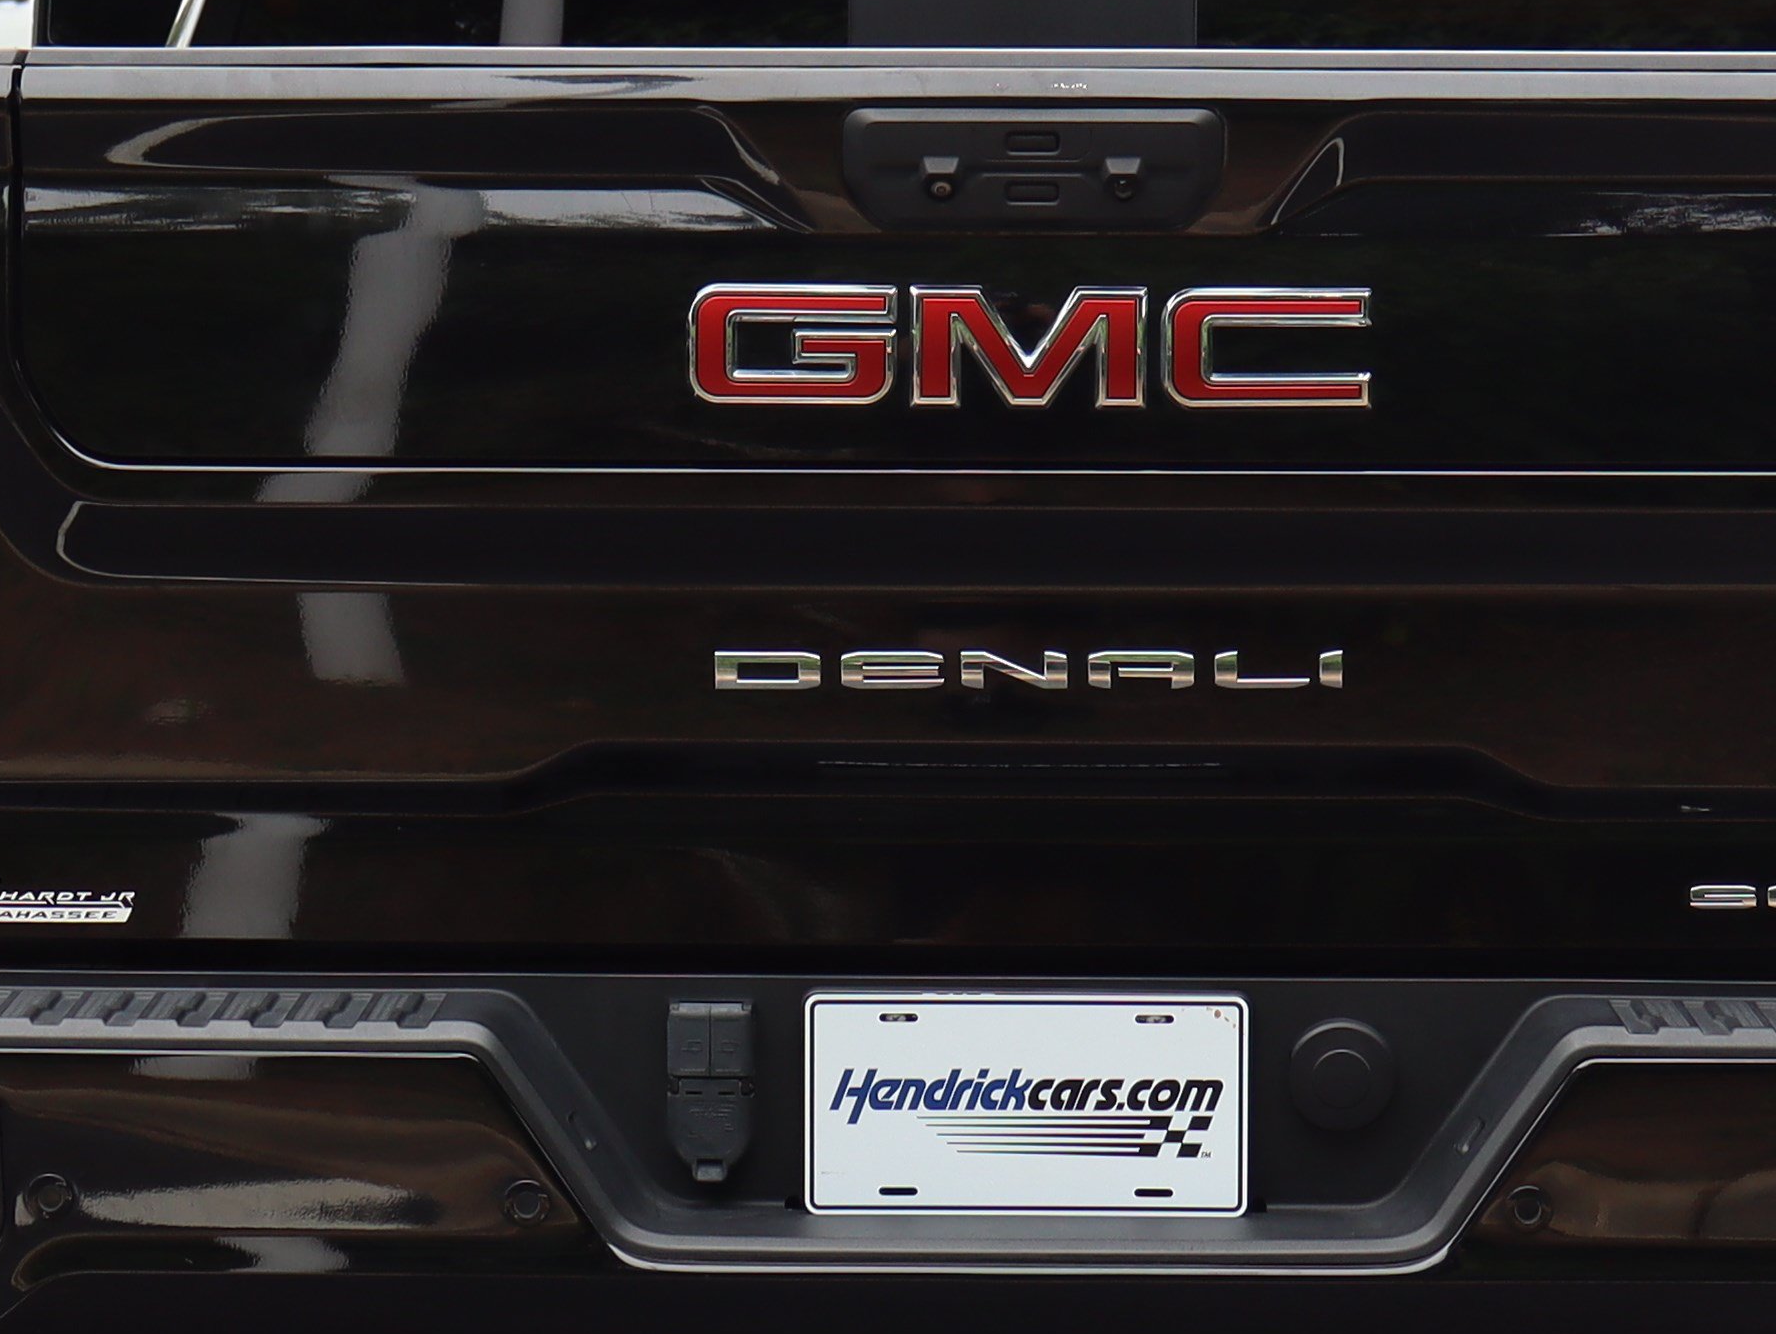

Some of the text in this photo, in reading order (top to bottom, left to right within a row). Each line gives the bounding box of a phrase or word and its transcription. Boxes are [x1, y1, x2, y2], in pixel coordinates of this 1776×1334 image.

[688, 283, 1372, 409] GMC
[714, 650, 1343, 689] DENALI
[100, 891, 136, 906] JR
[828, 1067, 1225, 1125] Hendrickcars.com
